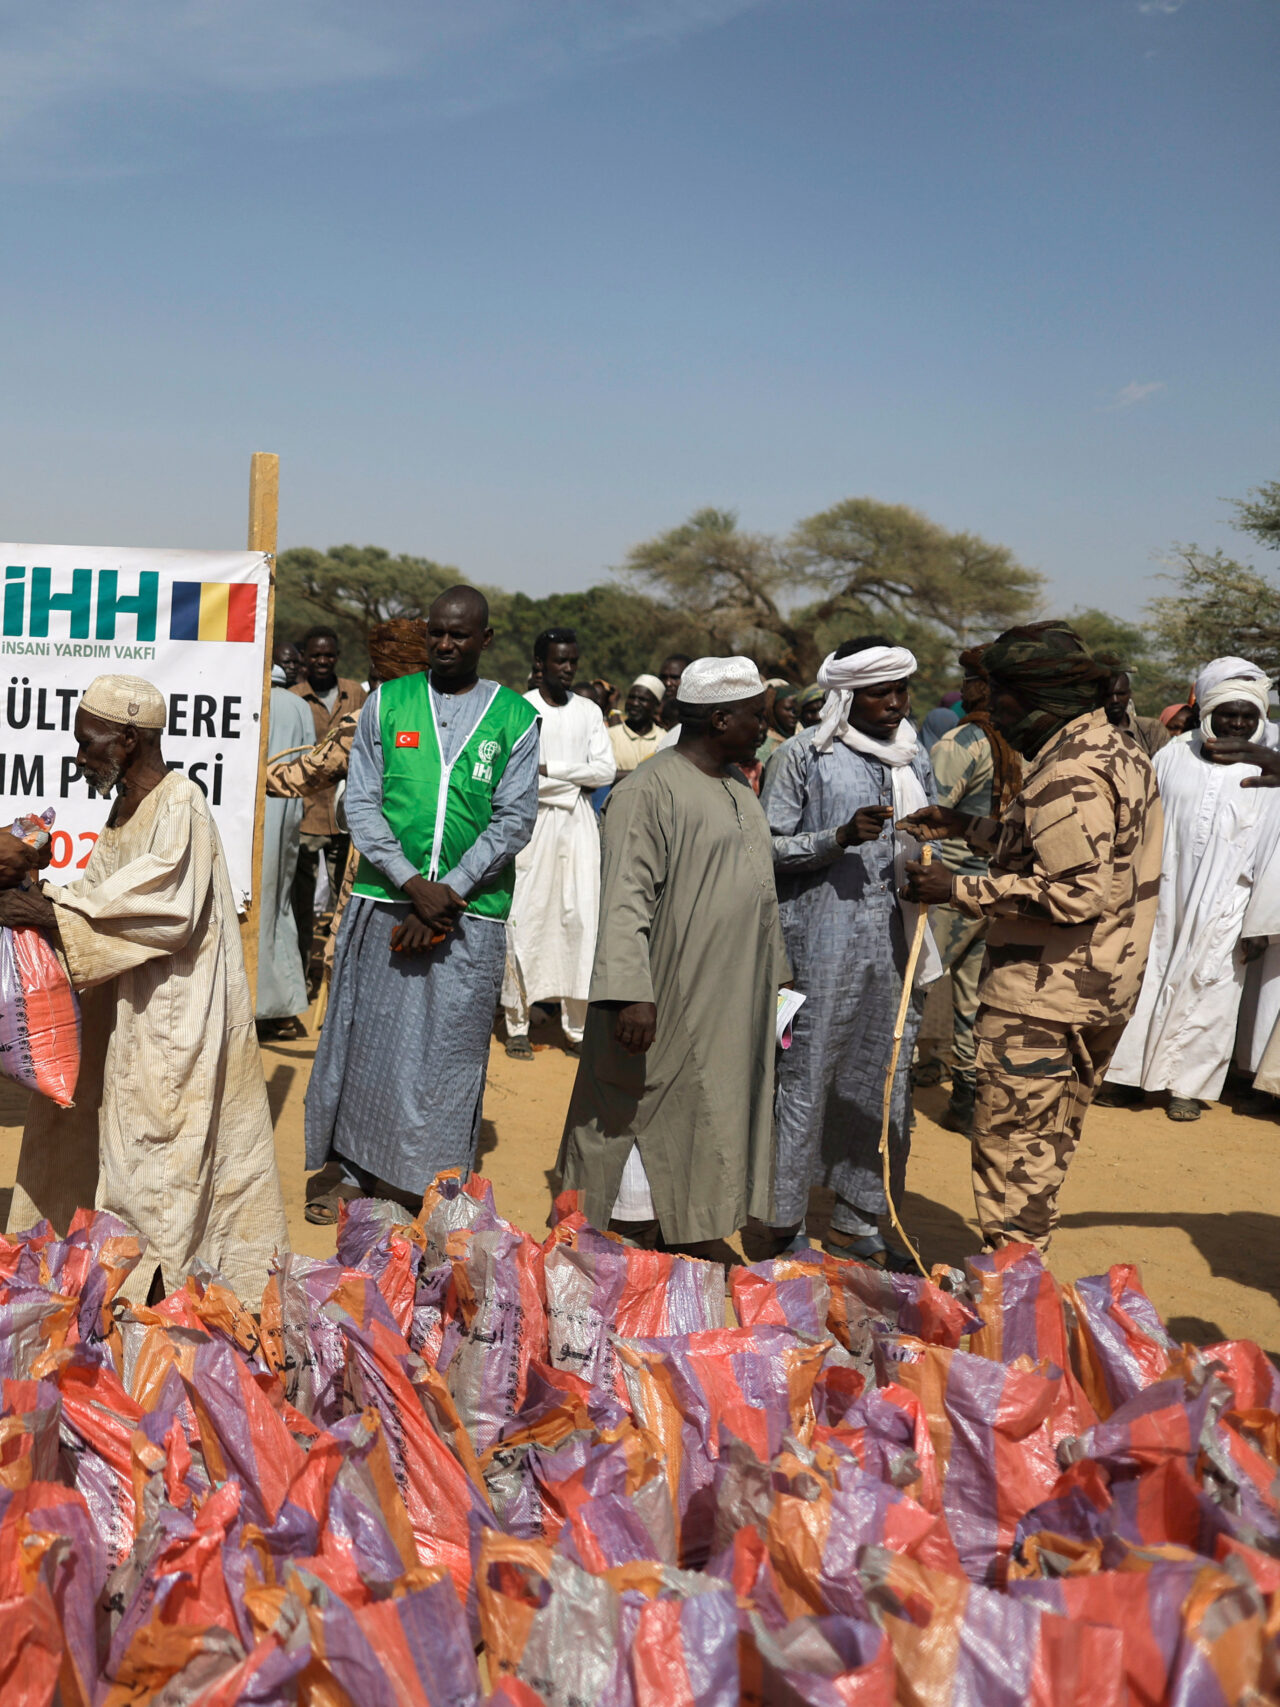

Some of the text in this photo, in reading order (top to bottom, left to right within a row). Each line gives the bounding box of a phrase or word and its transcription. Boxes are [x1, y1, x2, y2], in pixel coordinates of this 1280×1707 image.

[54, 643, 111, 659] YARDIM
[114, 645, 156, 661] VAKFI
[51, 830, 100, 869] 02
